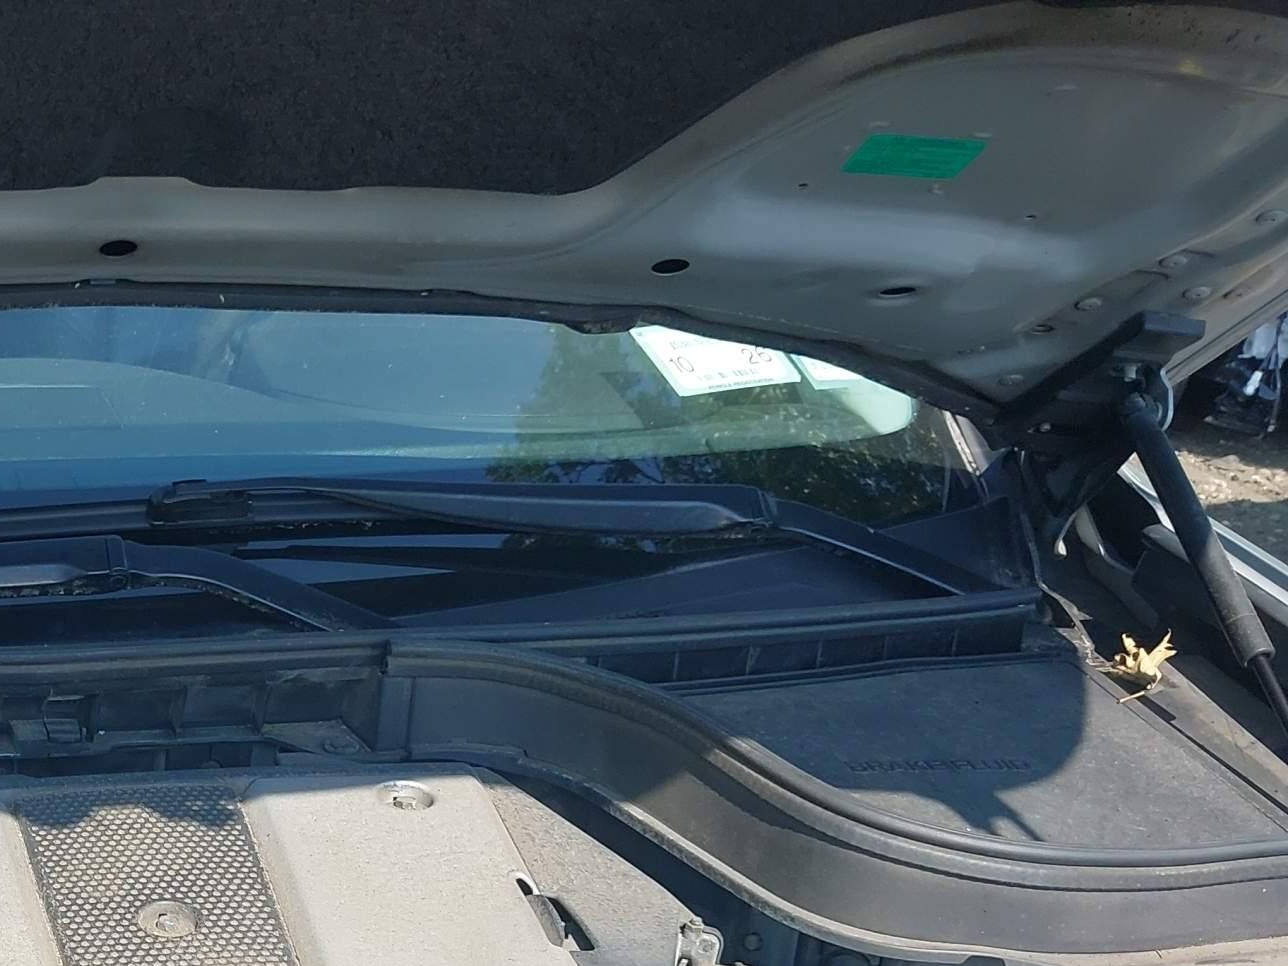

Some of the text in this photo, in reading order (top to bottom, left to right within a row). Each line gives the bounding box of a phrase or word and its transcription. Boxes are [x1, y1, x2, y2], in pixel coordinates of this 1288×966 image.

[669, 356, 696, 374] 10
[740, 345, 773, 366] 26
[846, 757, 1032, 774] BRAKE FLUID
